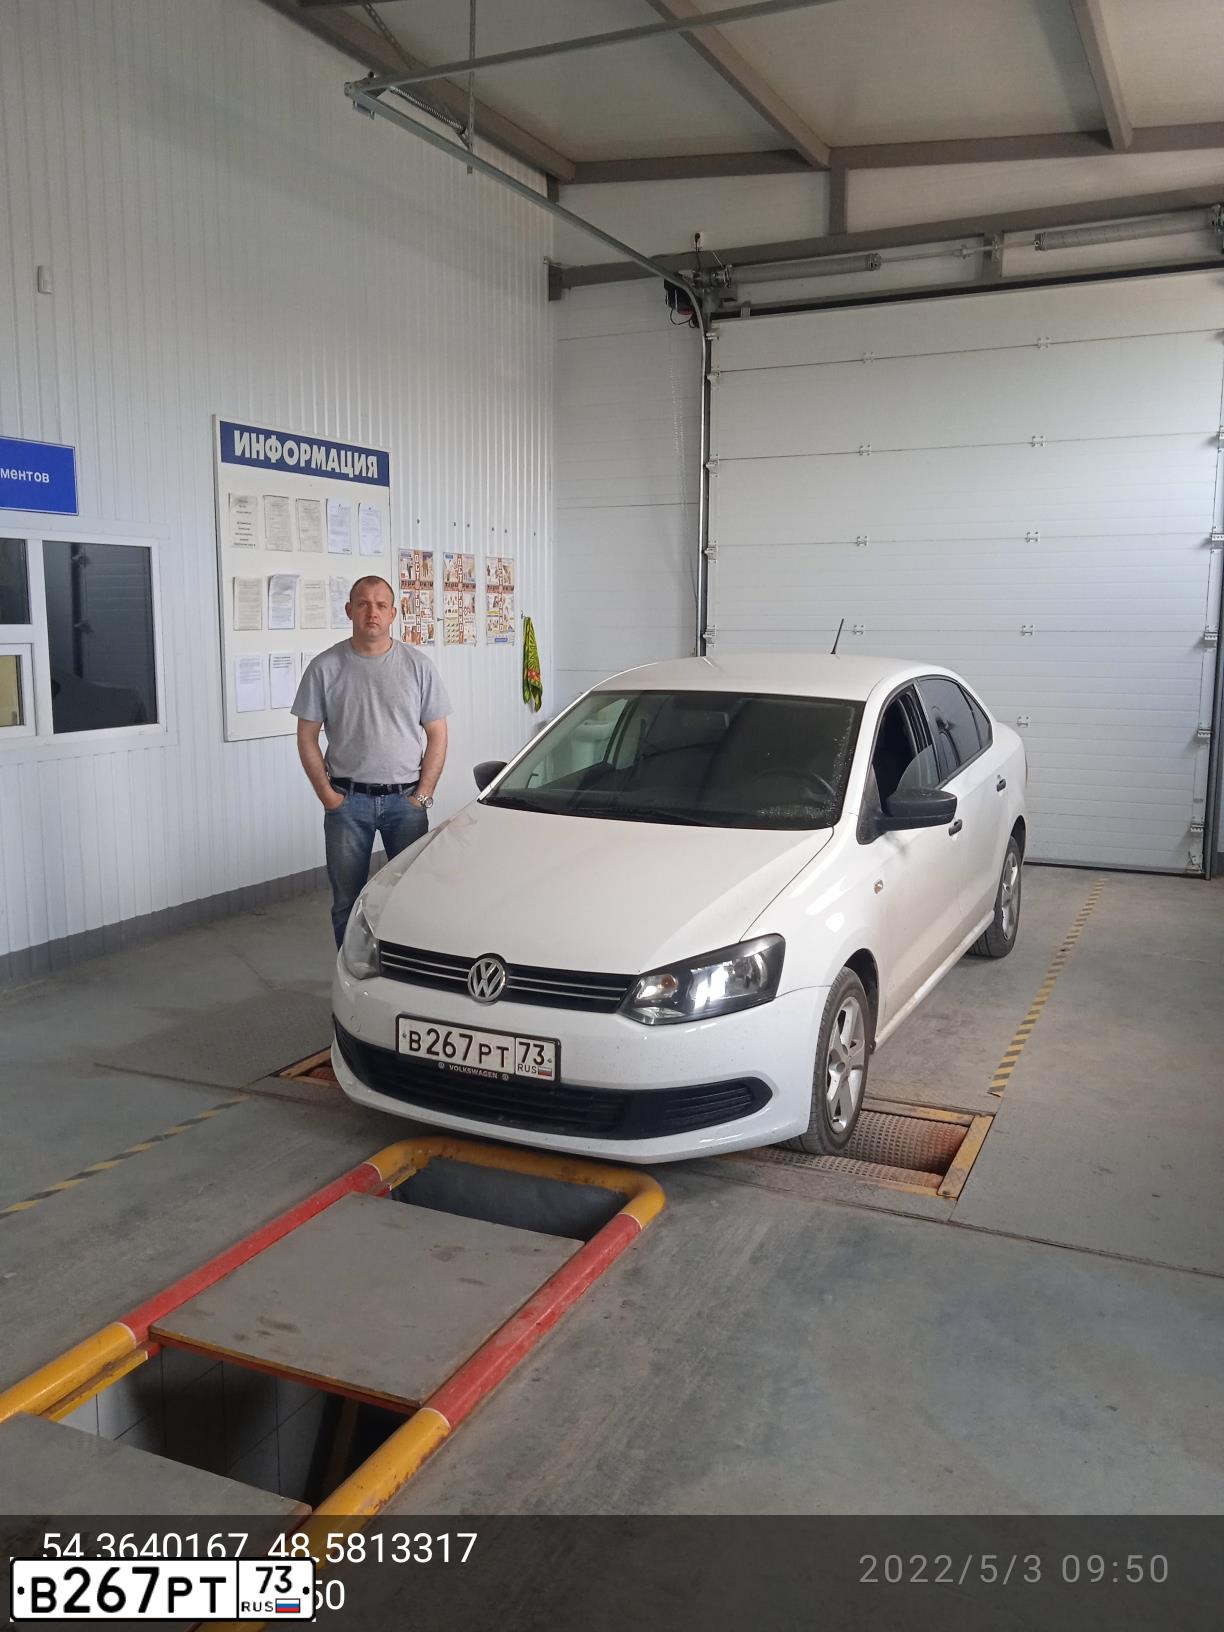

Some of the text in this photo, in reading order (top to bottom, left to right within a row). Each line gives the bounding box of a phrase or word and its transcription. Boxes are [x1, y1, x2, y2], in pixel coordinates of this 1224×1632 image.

[233, 429, 379, 479] ИНФОРМАЦИЯ
[0, 468, 50, 484] ментов
[518, 1041, 546, 1067] 73
[449, 1063, 498, 1080] VOLKSWAGEN
[517, 1062, 537, 1075] RUS
